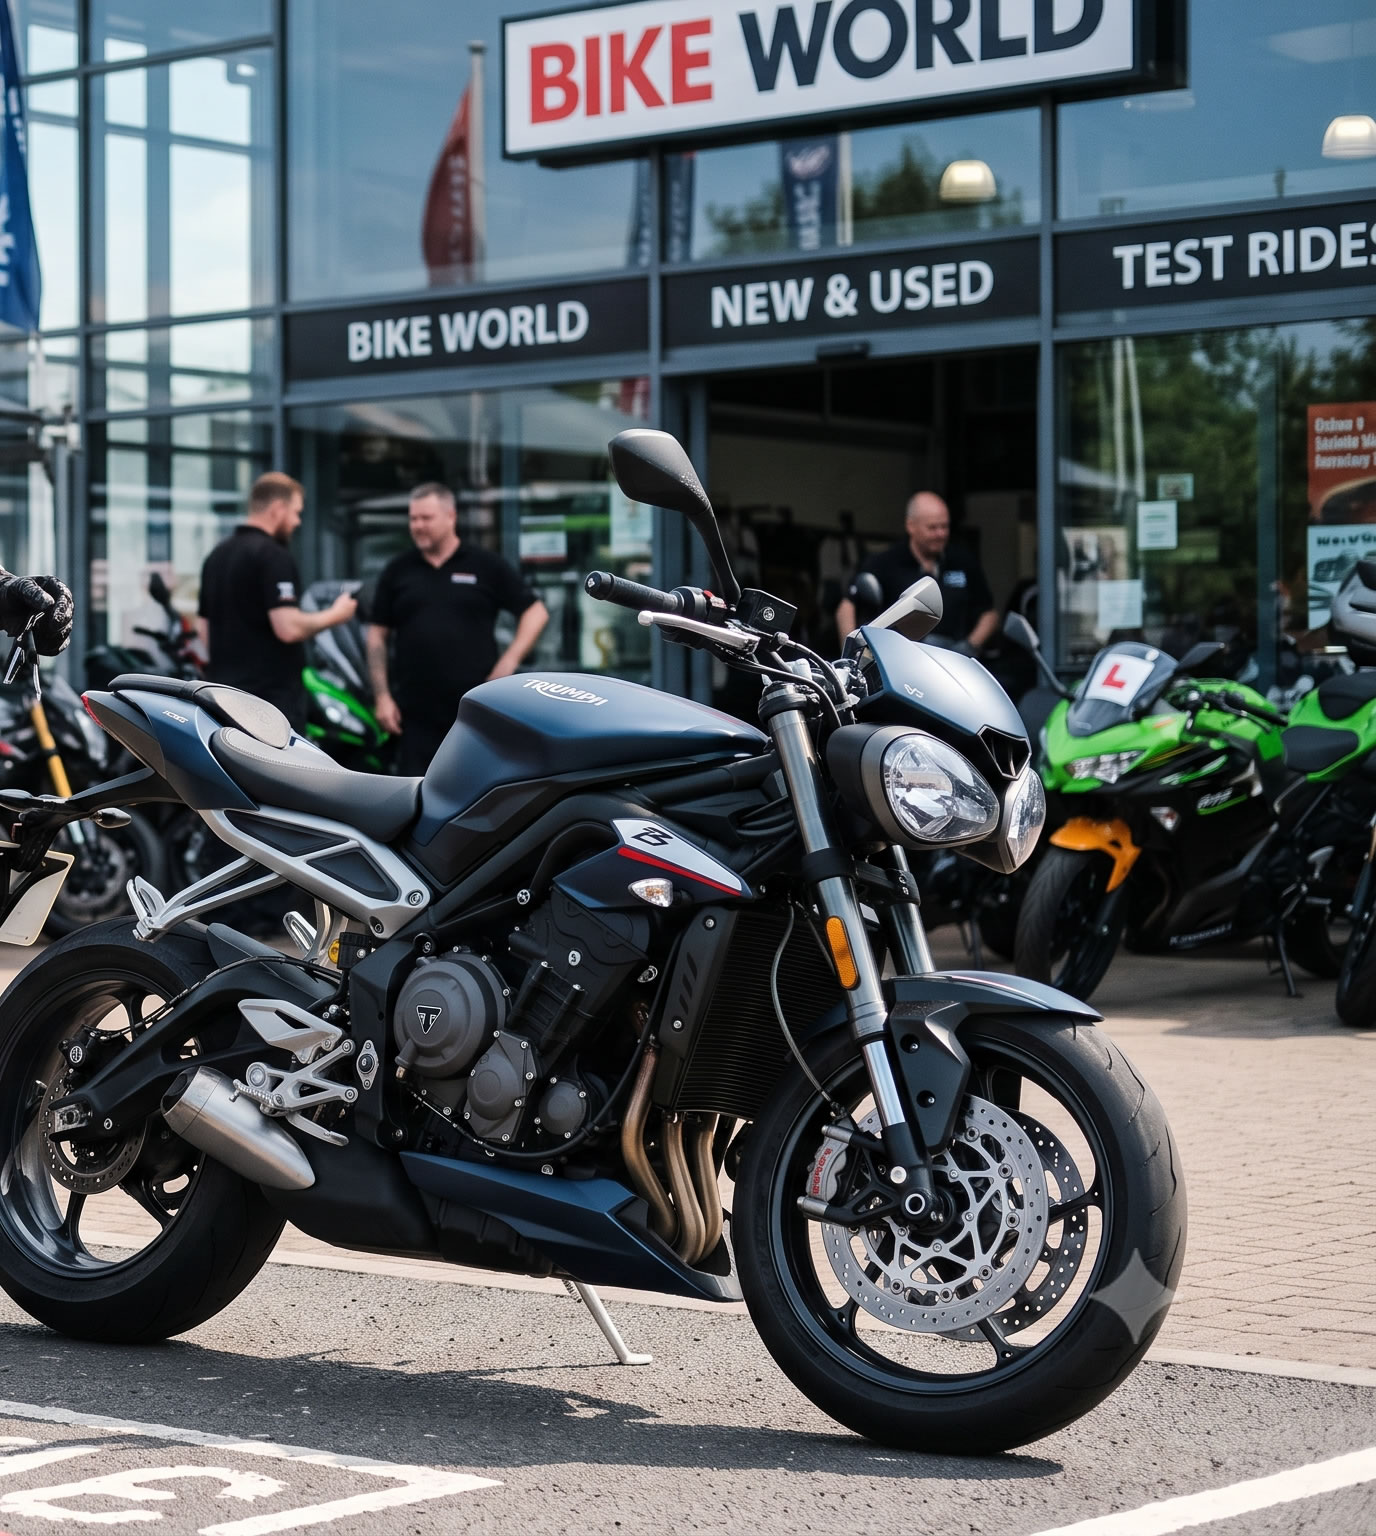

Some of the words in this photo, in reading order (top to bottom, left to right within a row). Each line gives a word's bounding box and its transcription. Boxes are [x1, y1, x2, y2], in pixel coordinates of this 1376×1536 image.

[529, 18, 714, 124] BIKE
[739, 0, 1104, 92] WORLD
[1113, 234, 1233, 289] TEST
[1248, 222, 1376, 277] RIDE
[711, 277, 814, 328] NEW
[824, 273, 859, 318] &
[869, 260, 994, 313] USED
[347, 315, 432, 362] BIKE
[439, 301, 589, 353] WORLD
[523, 679, 608, 706] TRIUMPH
[1102, 664, 1126, 688] L
